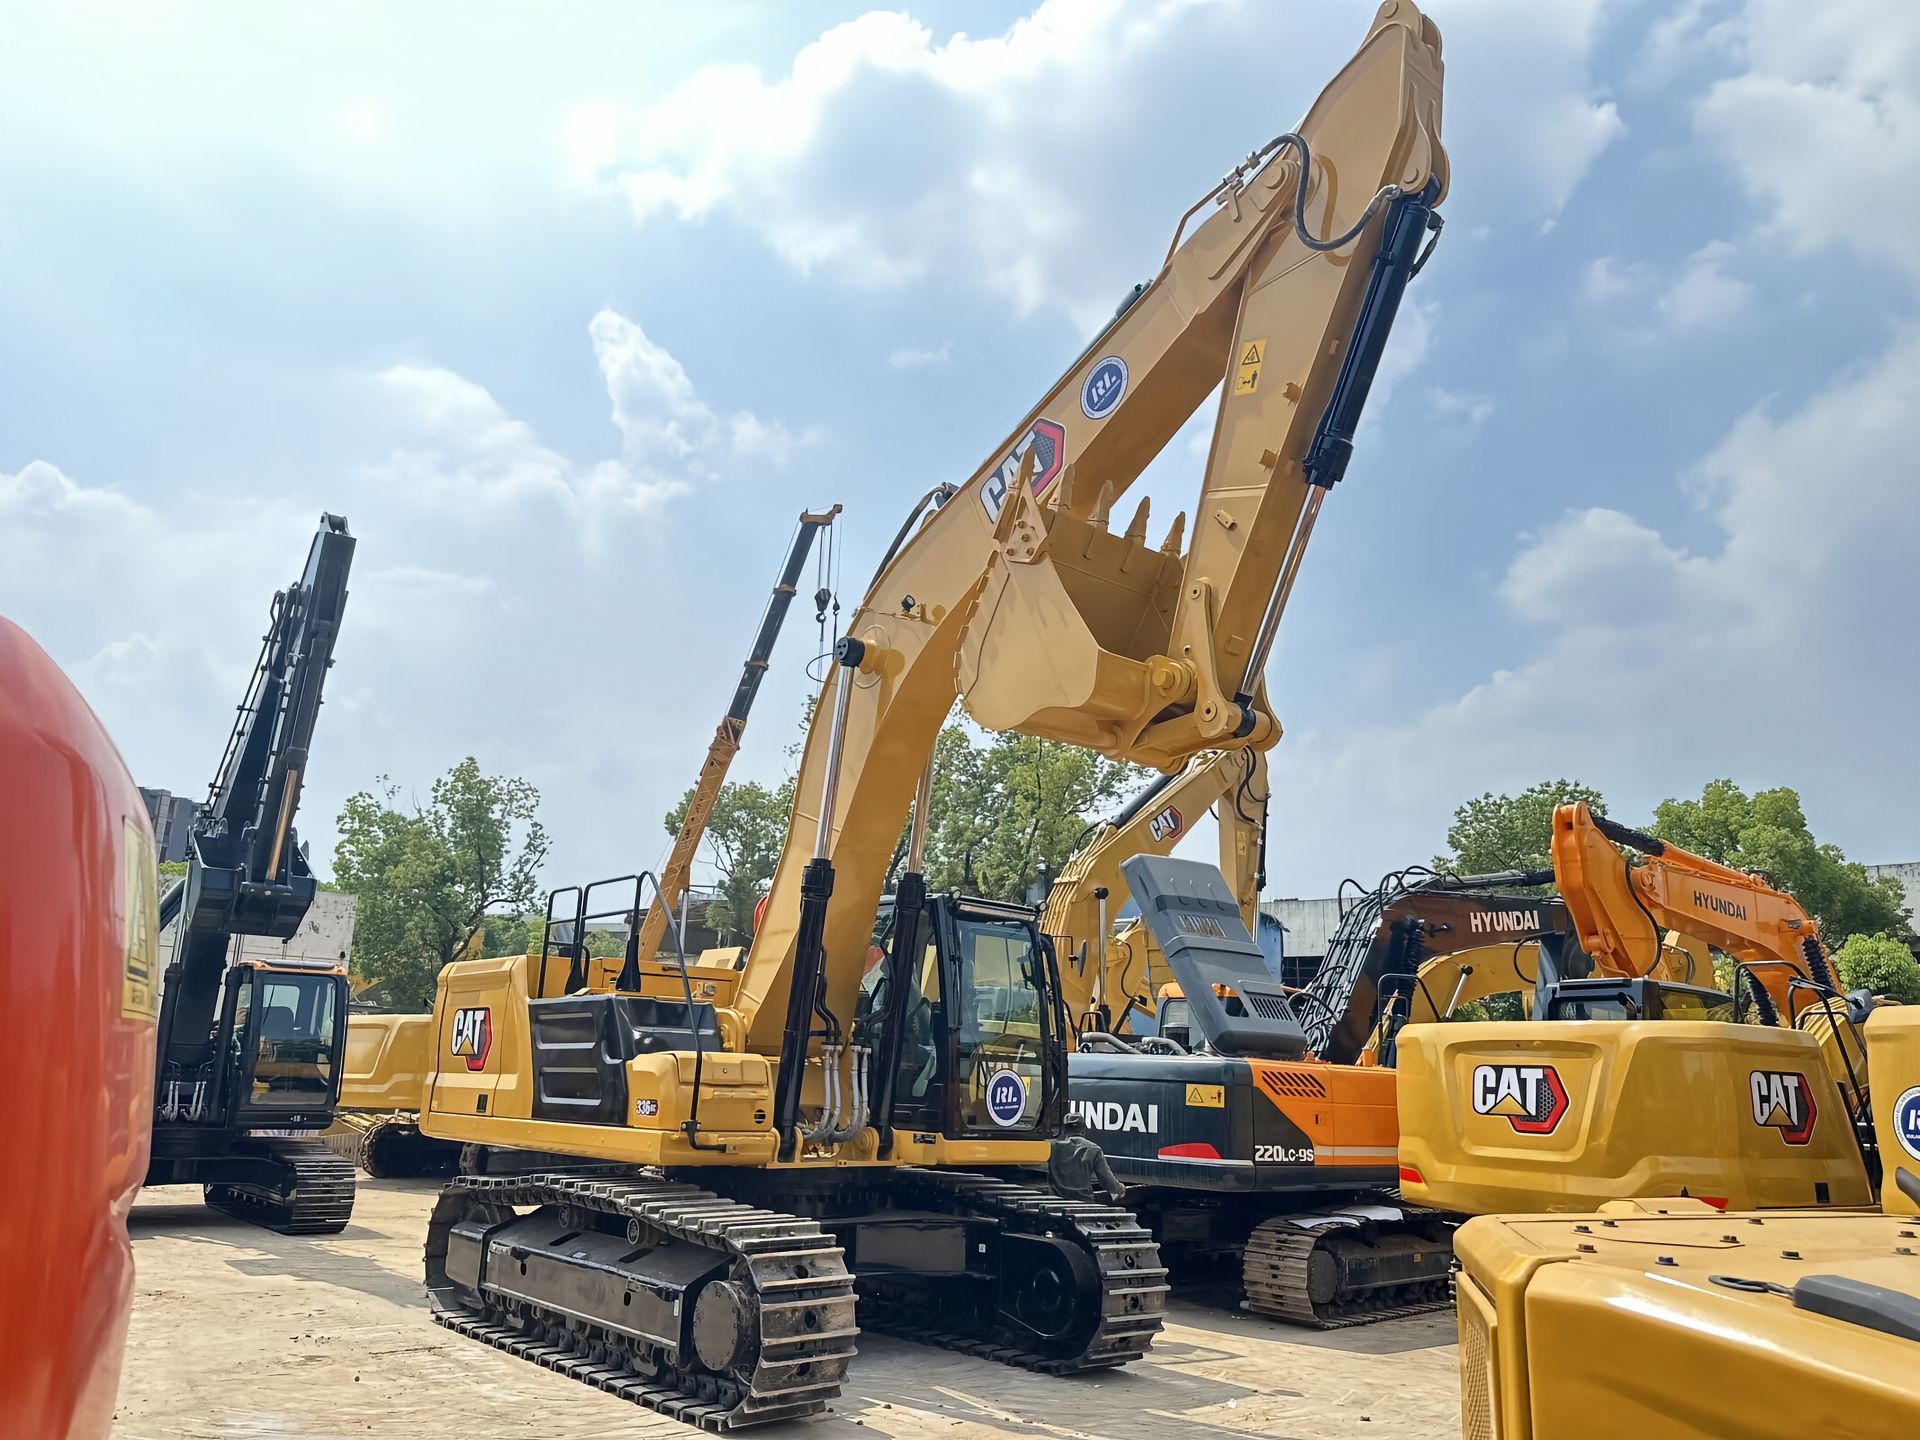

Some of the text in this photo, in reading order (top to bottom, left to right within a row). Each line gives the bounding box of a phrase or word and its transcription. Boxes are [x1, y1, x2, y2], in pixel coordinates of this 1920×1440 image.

[1149, 808, 1176, 842] CAT
[1469, 910, 1541, 933] HYUNDAI
[1693, 889, 1747, 921] HYUNDAI
[451, 1009, 486, 1055] CAT
[1473, 1065, 1544, 1116] CAT
[1750, 1071, 1799, 1126] CAT
[1069, 1100, 1158, 1134] UNDAI
[1254, 1145, 1315, 1161] 220LC-9S
